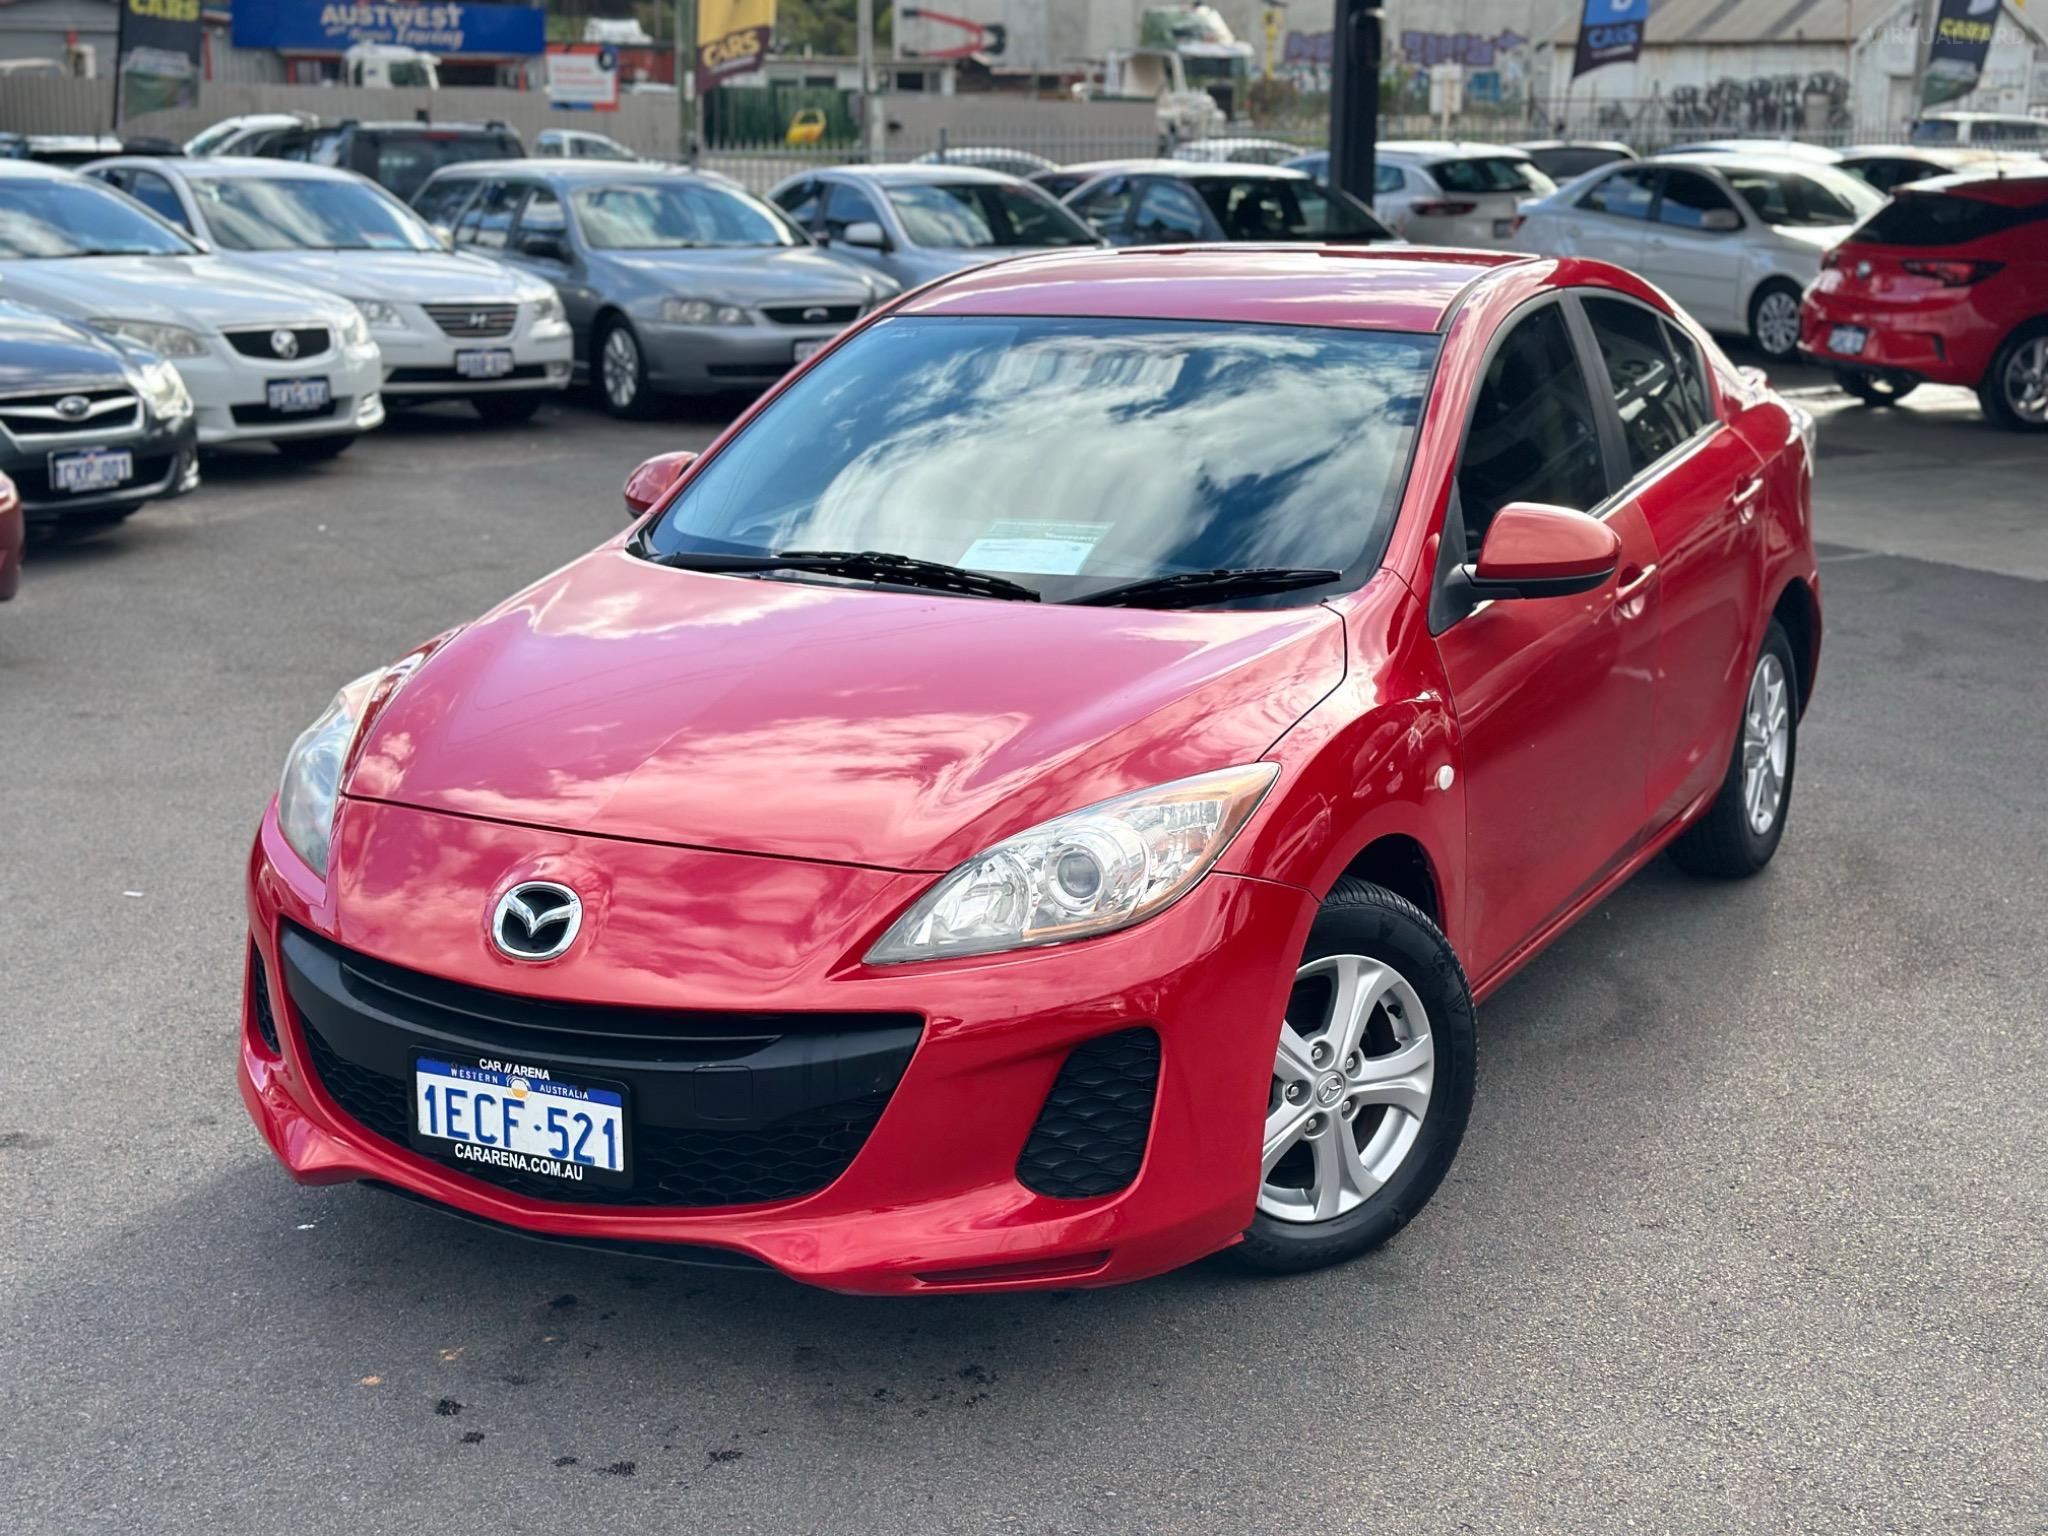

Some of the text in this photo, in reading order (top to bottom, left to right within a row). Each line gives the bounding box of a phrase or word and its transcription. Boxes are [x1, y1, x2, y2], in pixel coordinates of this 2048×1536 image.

[320, 2, 464, 29] AUSTWEST
[703, 31, 760, 68] CARS
[479, 1058, 502, 1073] CAR
[451, 1069, 589, 1100] WESTERN AUSTRALIA
[454, 1143, 584, 1181] CARARENA.COM.AU
